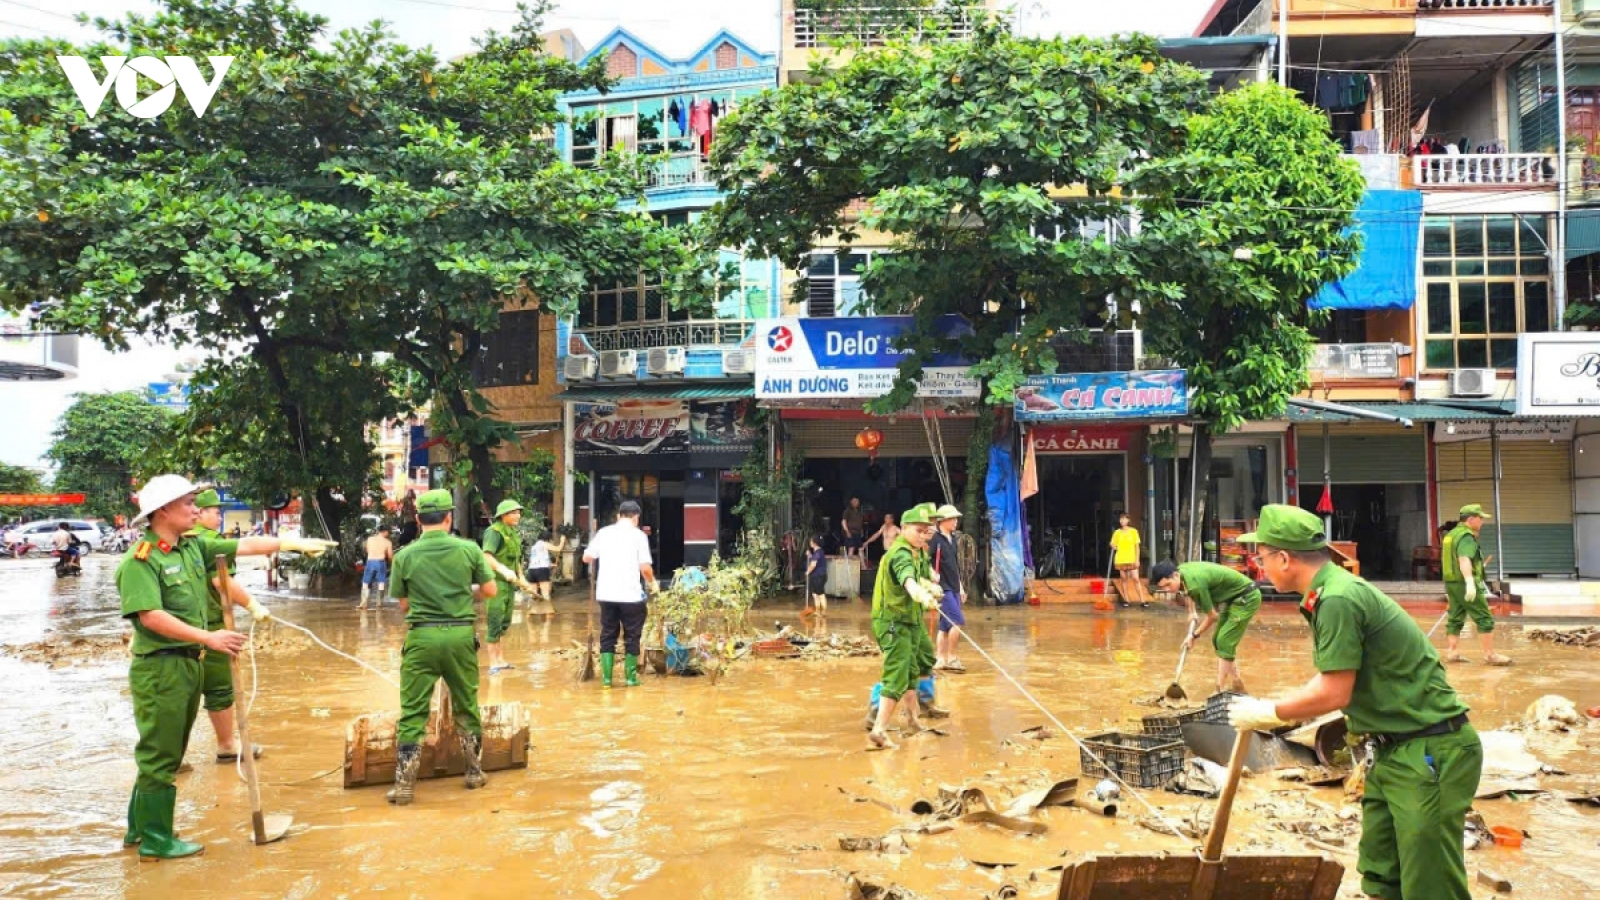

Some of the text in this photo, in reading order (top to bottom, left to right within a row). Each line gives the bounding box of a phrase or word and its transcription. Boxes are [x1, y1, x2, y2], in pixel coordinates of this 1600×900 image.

[826, 330, 878, 356] Delo
[799, 374, 849, 393] DƯƠNG
[573, 417, 681, 442] COFFEE
[1034, 434, 1060, 450] CÁ
